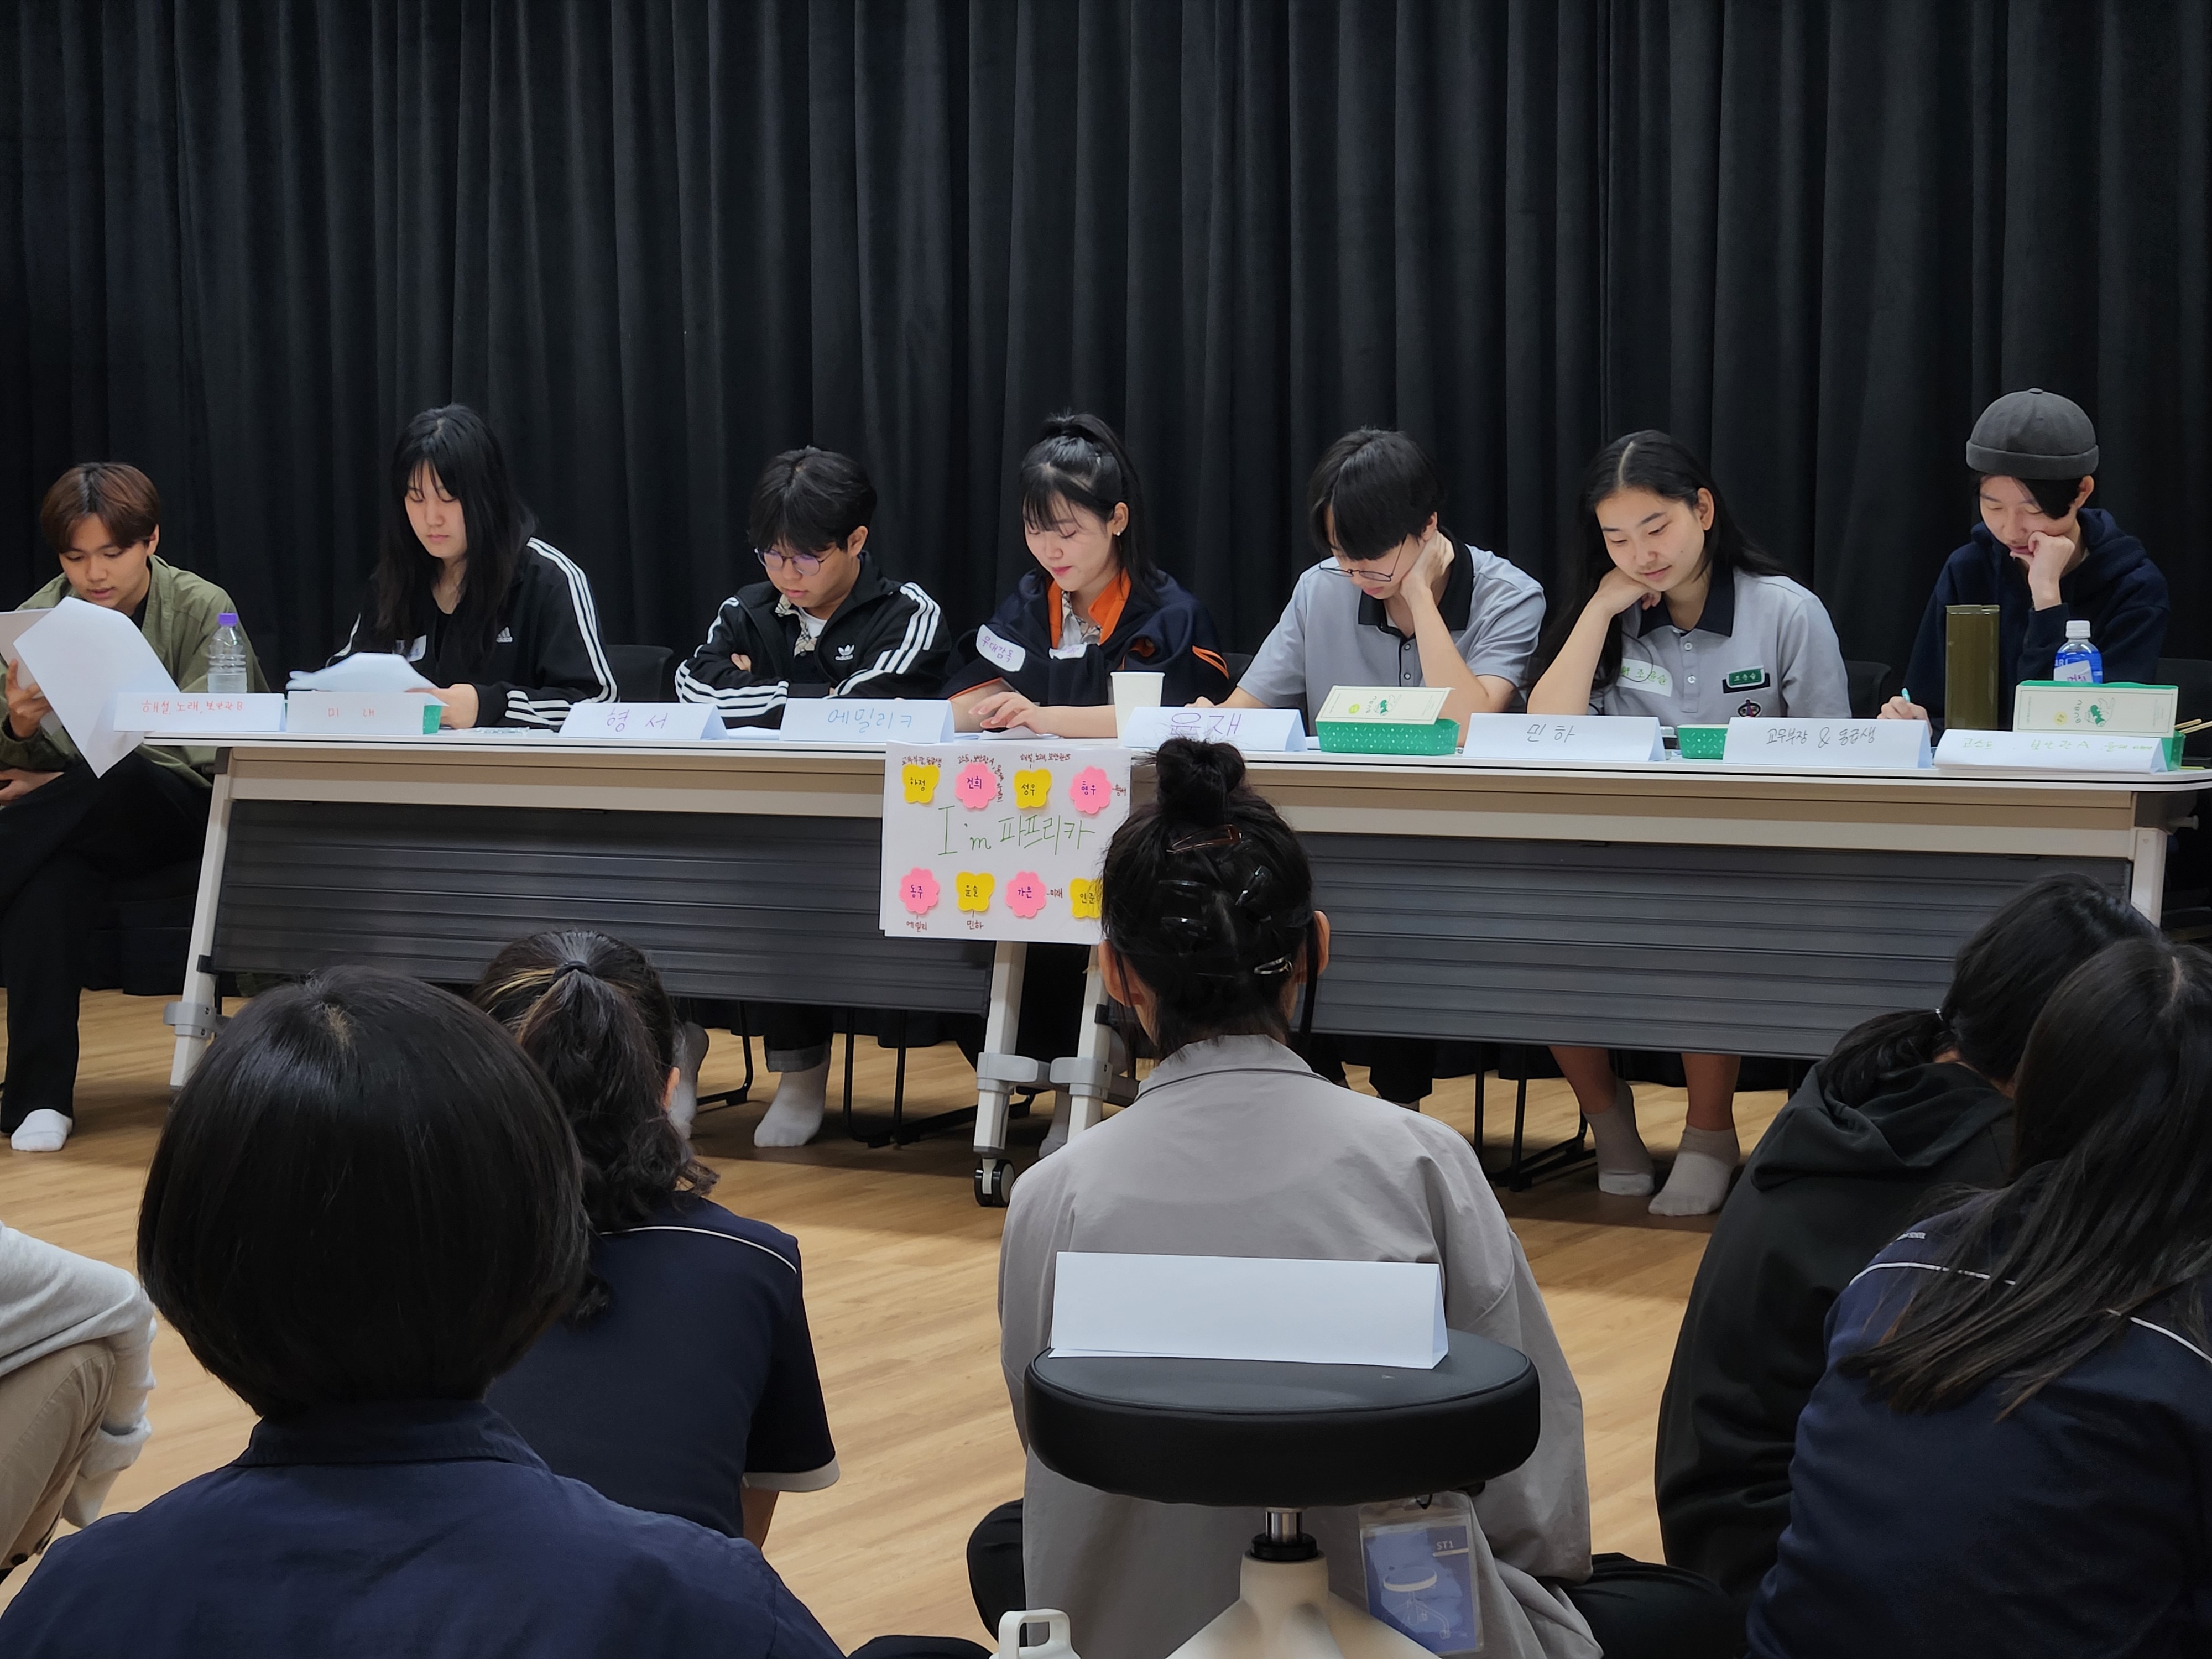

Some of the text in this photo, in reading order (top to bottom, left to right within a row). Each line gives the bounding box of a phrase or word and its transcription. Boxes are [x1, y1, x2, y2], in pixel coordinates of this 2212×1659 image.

[981, 635, 1014, 662] 무대감독
[2074, 699, 2083, 724] BUBU
[1766, 727, 1876, 748] 교무부장 & 동급생
[910, 777, 925, 791] 하정
[967, 775, 982, 789] 건희
[1021, 784, 1036, 796] 성우
[998, 815, 1096, 855] 파프리카
[911, 885, 923, 899] 동주
[965, 885, 978, 897] 윤슬
[1018, 886, 1032, 899] 가은
[967, 920, 984, 930] 민하
[1437, 1541, 1454, 1550] ST1
